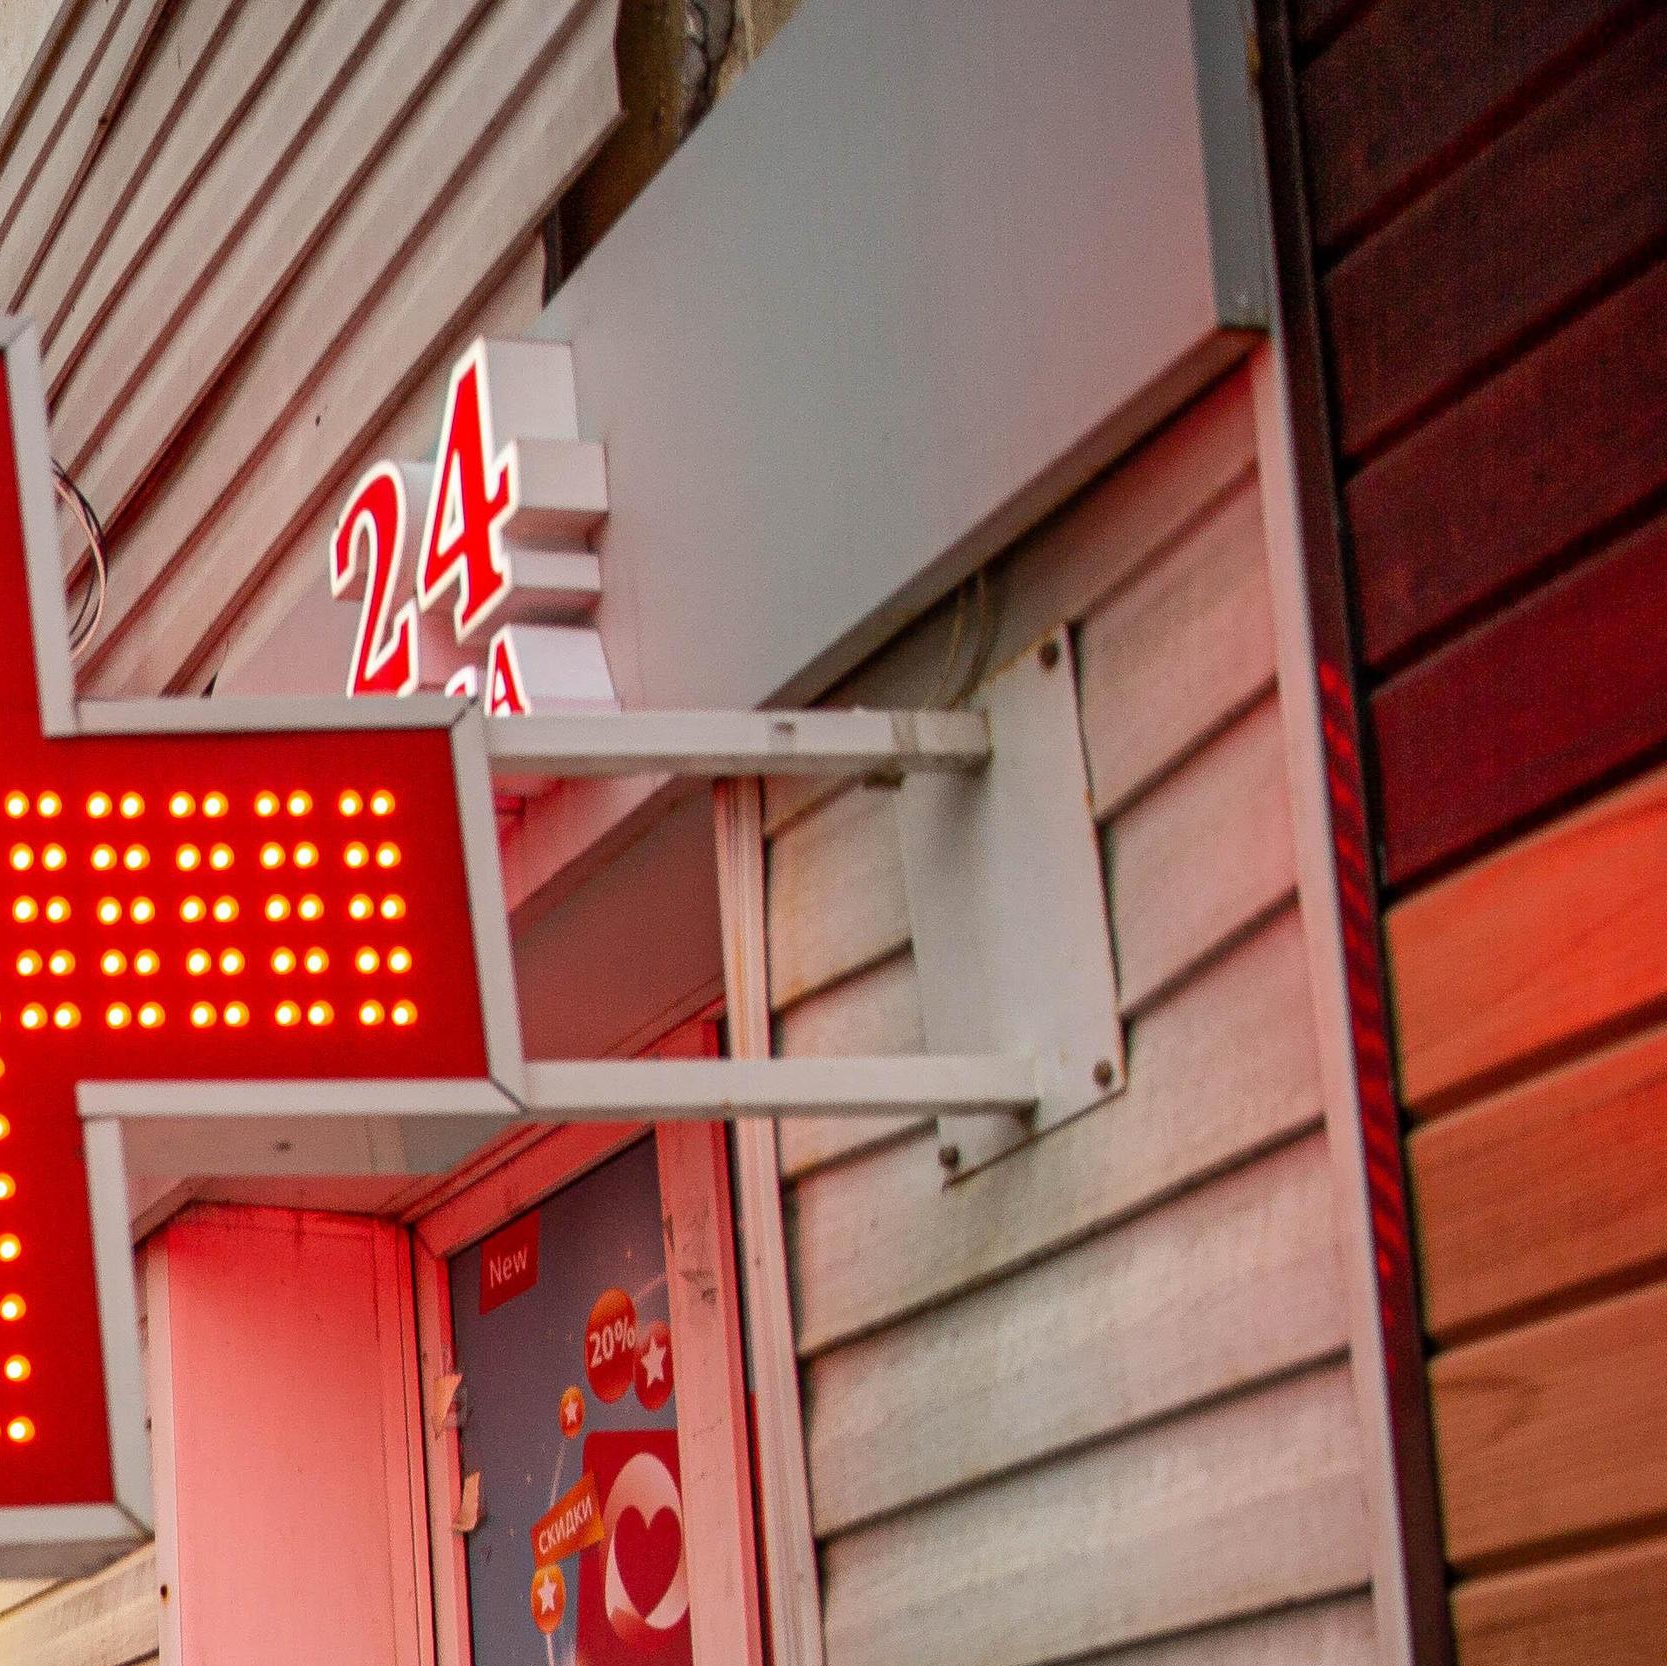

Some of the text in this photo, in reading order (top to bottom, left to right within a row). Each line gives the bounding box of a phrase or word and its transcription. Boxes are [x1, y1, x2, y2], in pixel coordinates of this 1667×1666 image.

[330, 336, 519, 698] 24
[488, 1246, 529, 1289] New
[588, 1315, 636, 1369] 20%
[538, 1494, 593, 1556] СКИДКИ
